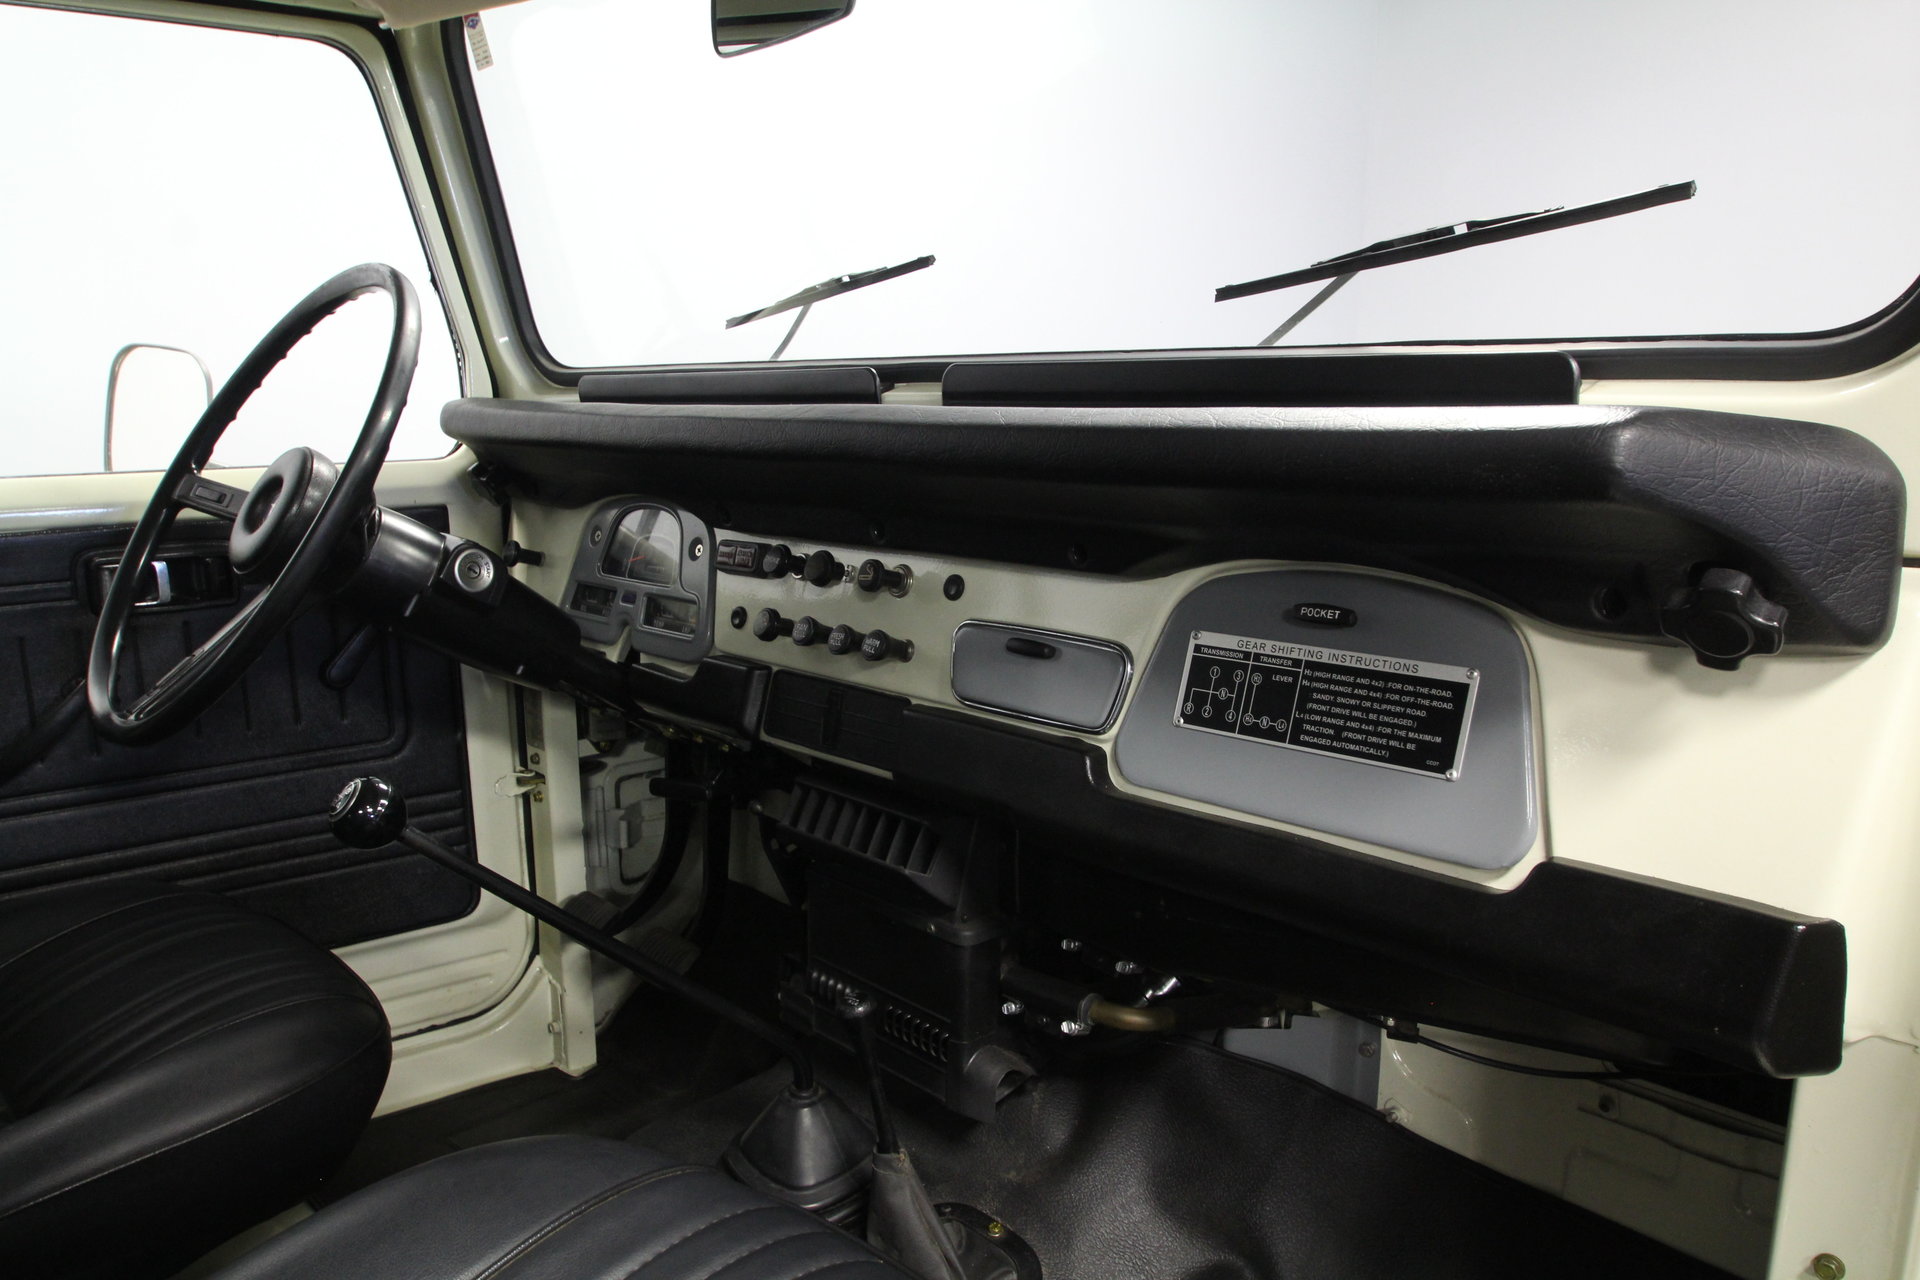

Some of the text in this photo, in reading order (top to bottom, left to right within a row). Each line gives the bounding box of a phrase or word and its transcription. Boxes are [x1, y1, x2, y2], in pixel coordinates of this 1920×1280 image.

[1300, 607, 1341, 620] POCKET
[863, 644, 875, 653] PULL
[1201, 647, 1244, 659] TRANSMISSION
[1237, 640, 1420, 674] GEAR SHIFTING INSTRUCTIONS
[1260, 656, 1293, 666] TRANSFER
[1272, 674, 1293, 683] LEVER
[1313, 671, 1331, 679] (HIGH
[1332, 673, 1355, 683] RANGE
[1355, 677, 1370, 685] AND
[1403, 684, 1453, 698] ON-THE-ROAD.
[1311, 681, 1329, 689] (HIGH
[1329, 684, 1352, 693] RANGE
[1353, 688, 1368, 696] AND
[1401, 695, 1454, 710] OFF-THE-ROAD.
[1336, 696, 1360, 705] SNOWY
[1372, 702, 1405, 711] SLIPPERY
[1306, 702, 1330, 711] (FRONT
[1331, 706, 1350, 716] DRIVE
[1351, 710, 1367, 719] WILL
[1368, 713, 1377, 721] BE
[1304, 713, 1321, 721] (LOW
[1322, 716, 1345, 726] RANGE
[1393, 729, 1407, 737] THE
[1408, 731, 1442, 743] MAXIMUM
[1300, 734, 1331, 746] ENGAGED
[1341, 731, 1366, 740] (FRONT
[1367, 735, 1387, 745] DRIVE
[1389, 739, 1405, 749] WILL
[1406, 742, 1416, 750] BE
